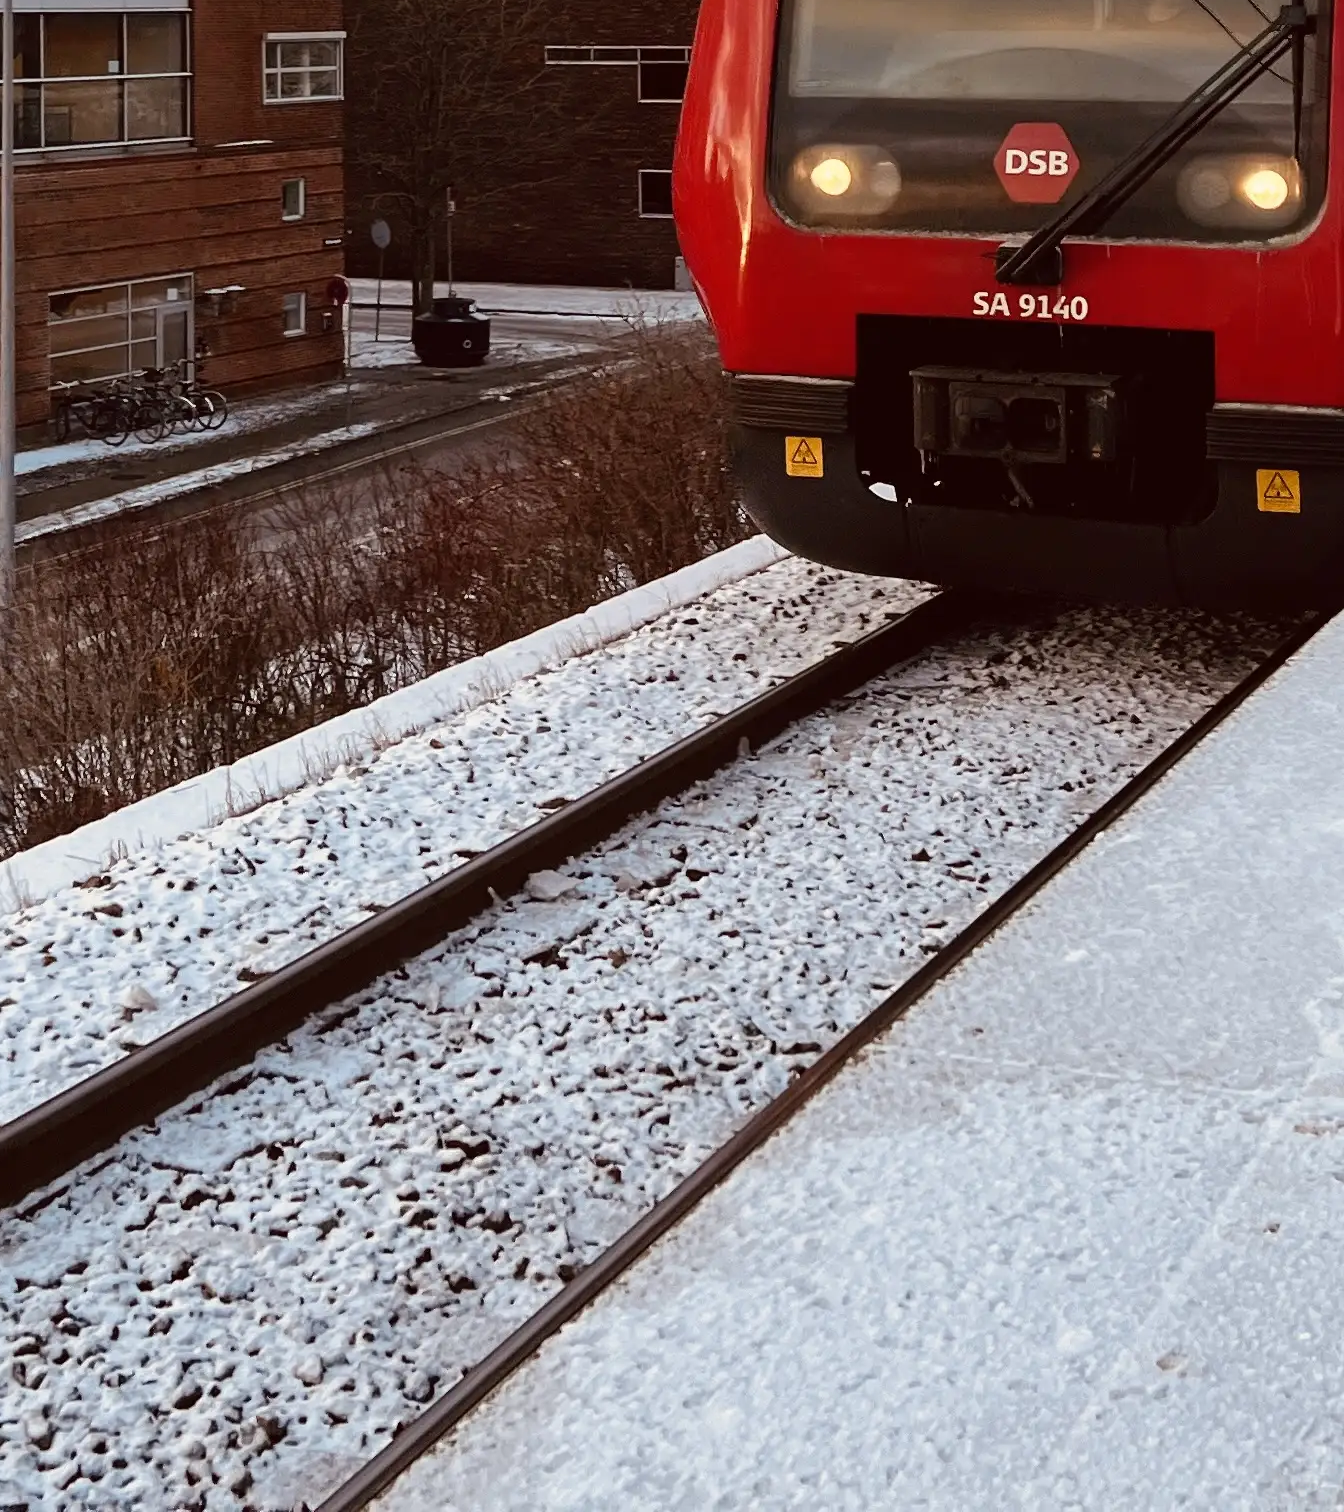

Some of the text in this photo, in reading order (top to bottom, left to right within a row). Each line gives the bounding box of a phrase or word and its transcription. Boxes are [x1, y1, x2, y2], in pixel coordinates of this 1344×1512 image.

[1004, 149, 1070, 176] DSB
[972, 291, 1089, 321] SA 9140
